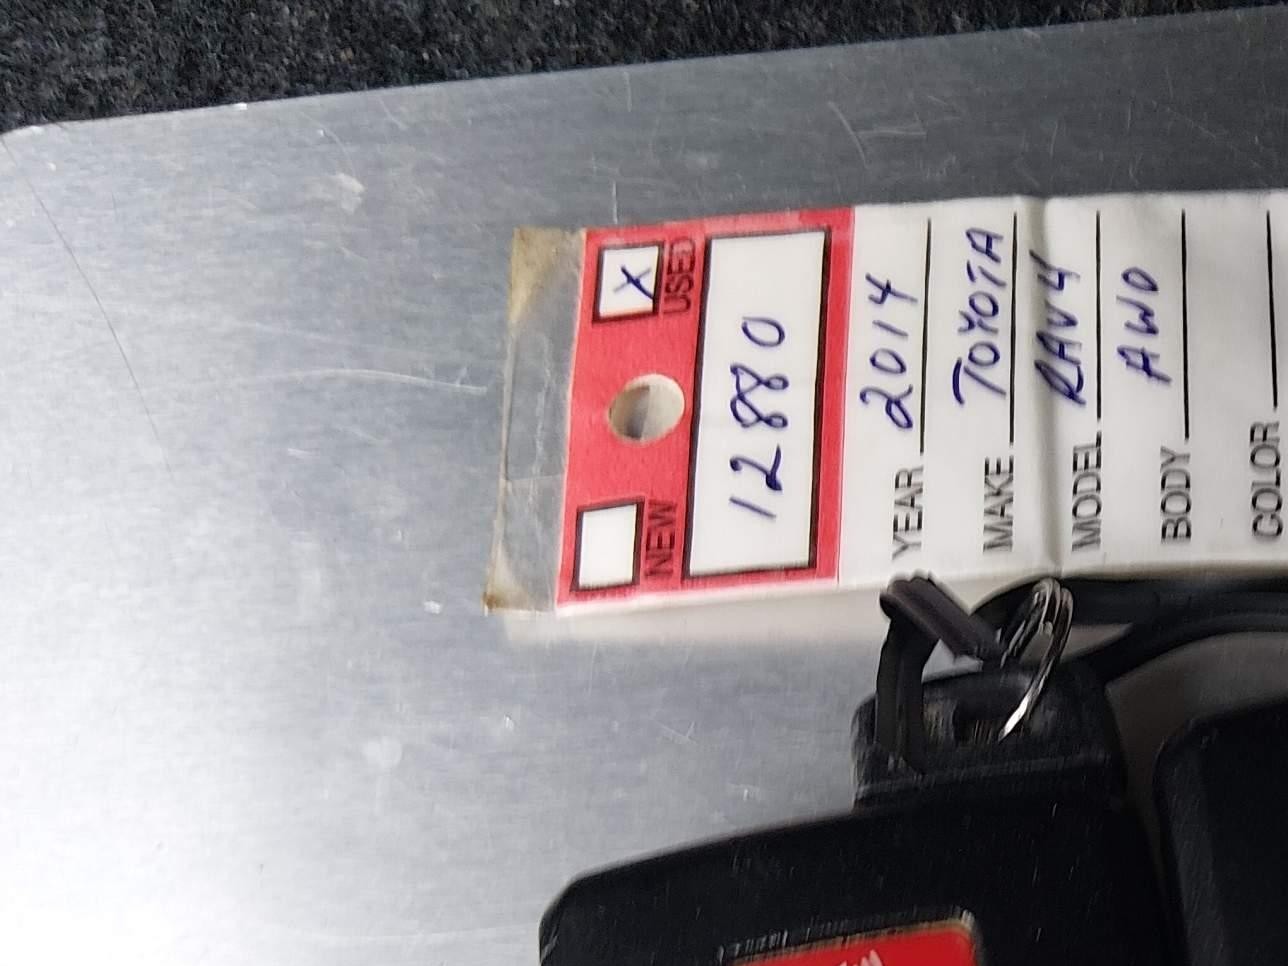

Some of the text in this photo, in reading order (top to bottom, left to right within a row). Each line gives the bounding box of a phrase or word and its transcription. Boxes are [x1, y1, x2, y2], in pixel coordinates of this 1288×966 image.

[614, 266, 654, 299] X
[663, 237, 696, 315] USED
[952, 227, 1007, 406] TOYOTA
[1029, 249, 1086, 407] RAV4
[1117, 266, 1172, 387] AWD
[860, 272, 919, 430] 2014
[730, 317, 788, 519] 12880
[645, 502, 675, 577] NEW
[892, 465, 924, 560] YEAR
[983, 455, 1014, 552] MAKE
[1072, 431, 1102, 552] MODEL
[1160, 446, 1191, 544] BODY
[1250, 421, 1283, 541] COLOR
